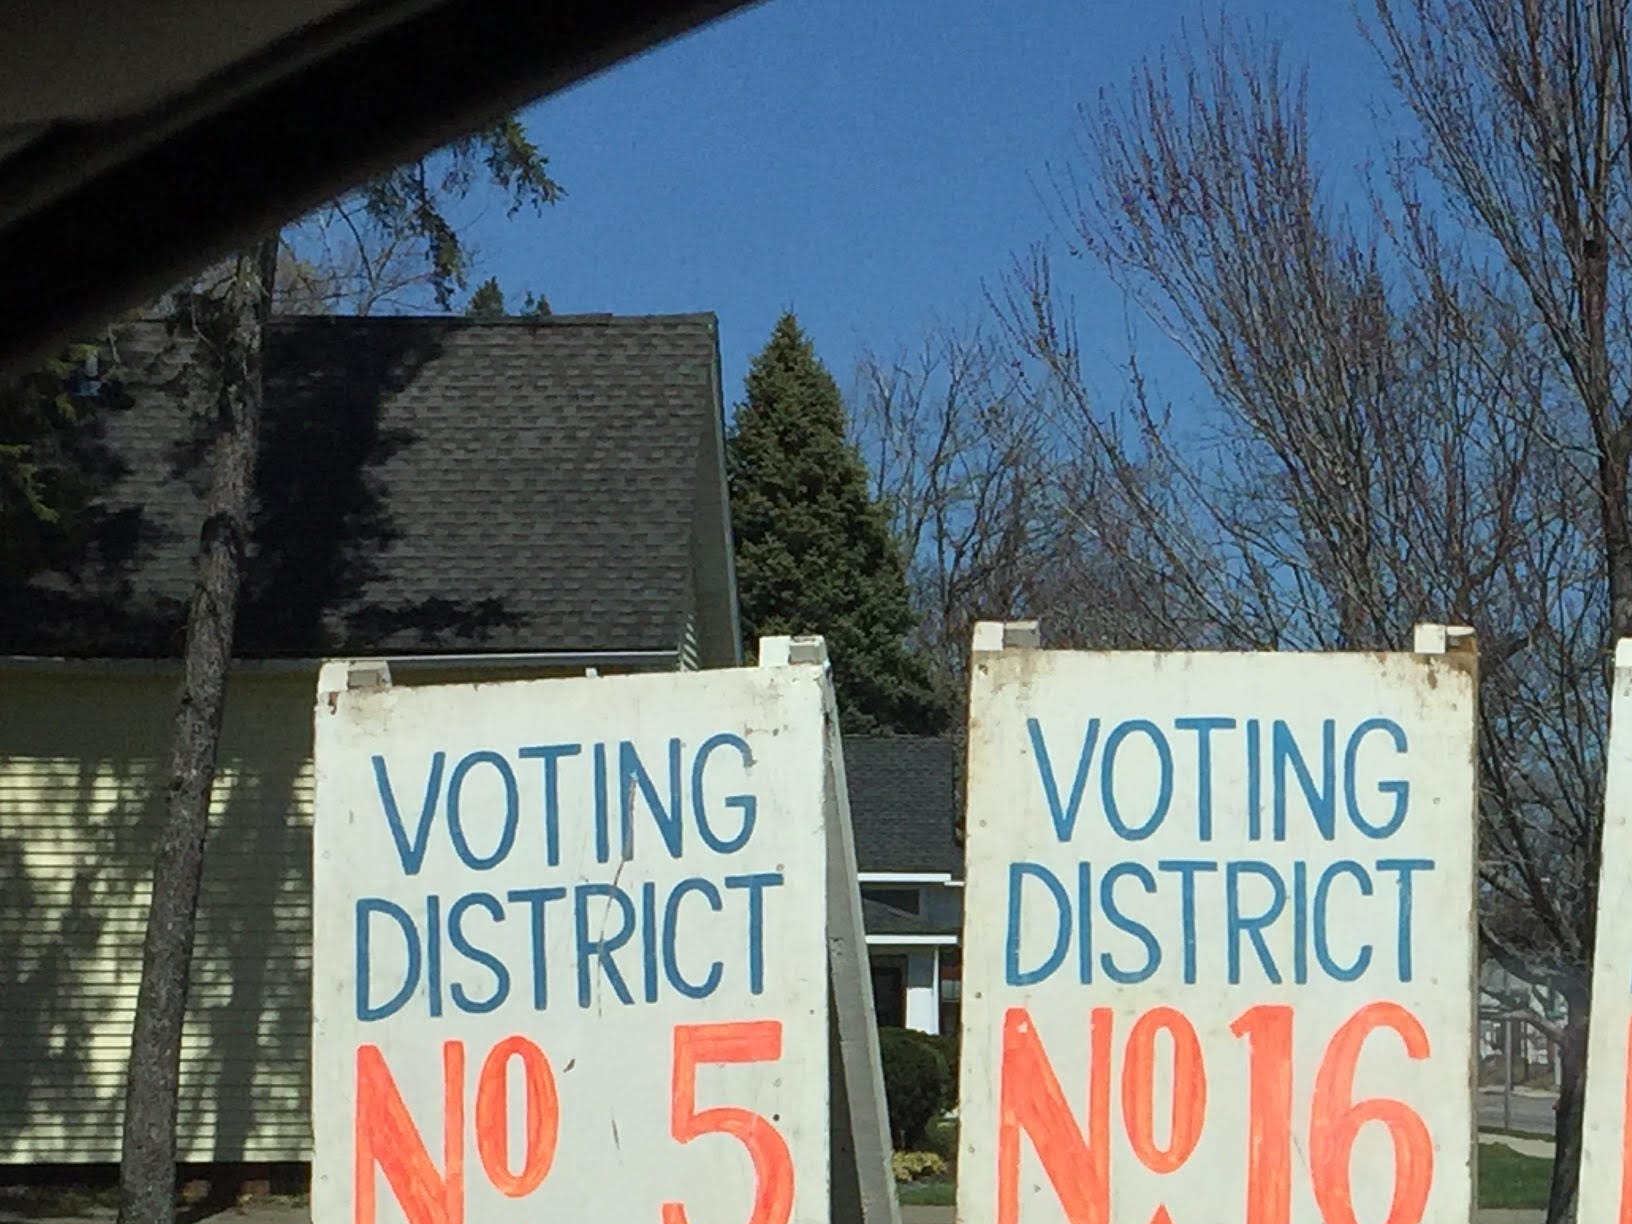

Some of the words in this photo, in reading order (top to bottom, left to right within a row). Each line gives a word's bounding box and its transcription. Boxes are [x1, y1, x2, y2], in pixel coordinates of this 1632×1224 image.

[370, 734, 756, 876] VOTING
[1026, 714, 1410, 843] VOTING
[356, 873, 784, 1022] DISTRICT
[1003, 856, 1436, 988] DISTRICT
